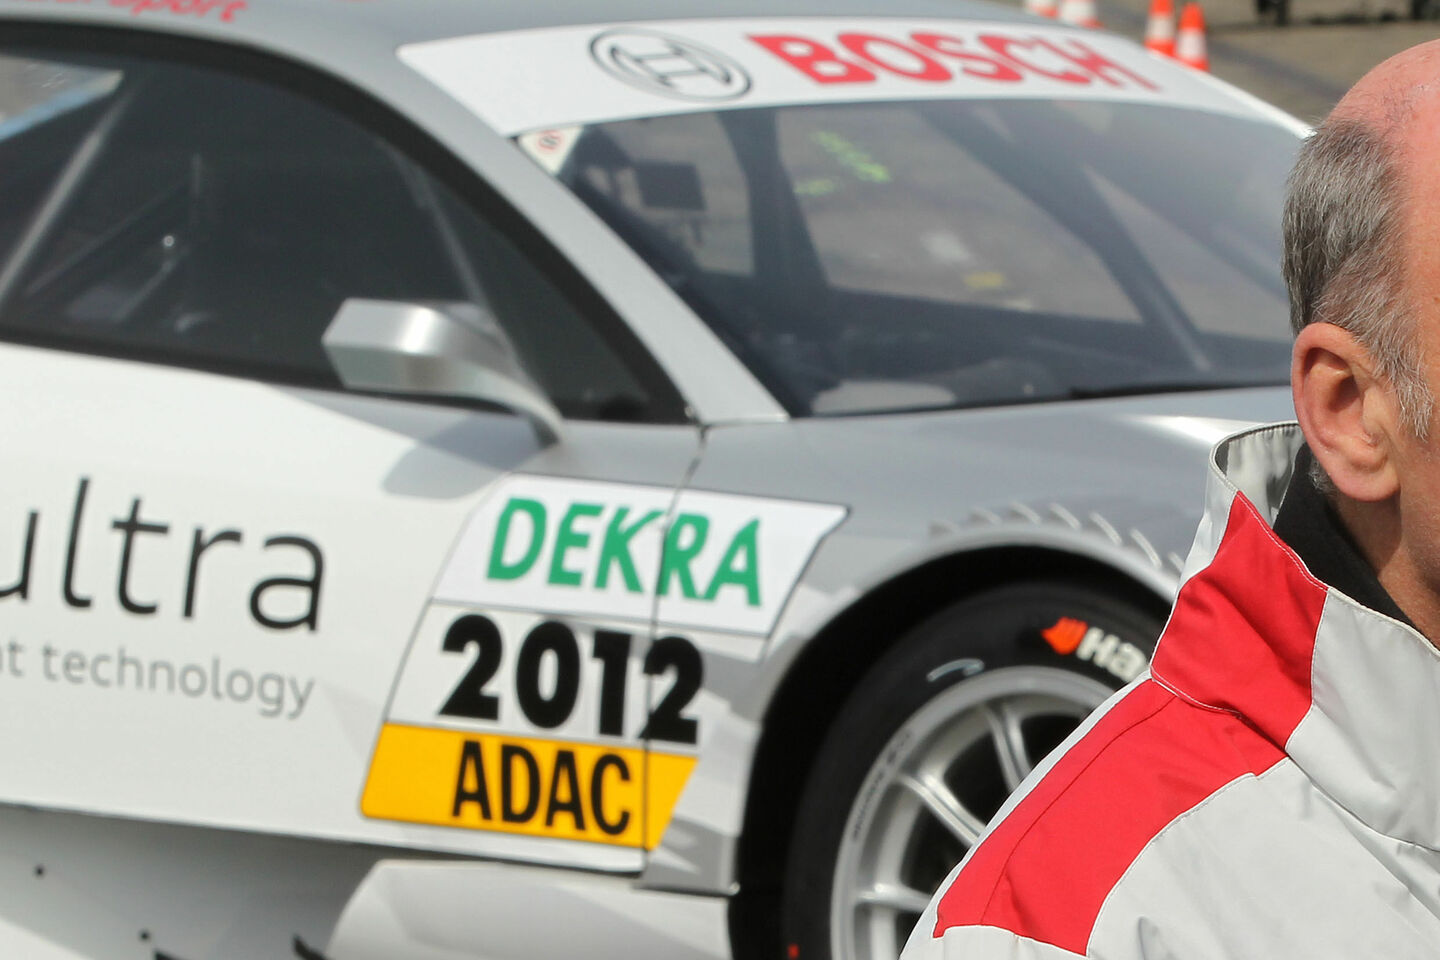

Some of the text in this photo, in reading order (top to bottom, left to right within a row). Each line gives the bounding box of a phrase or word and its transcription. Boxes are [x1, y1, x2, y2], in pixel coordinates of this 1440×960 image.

[745, 32, 1164, 92] BOSCH
[486, 496, 763, 608] DEKRA
[42, 643, 316, 720] technology
[437, 612, 704, 746] 2012
[451, 739, 633, 836] ADAC
